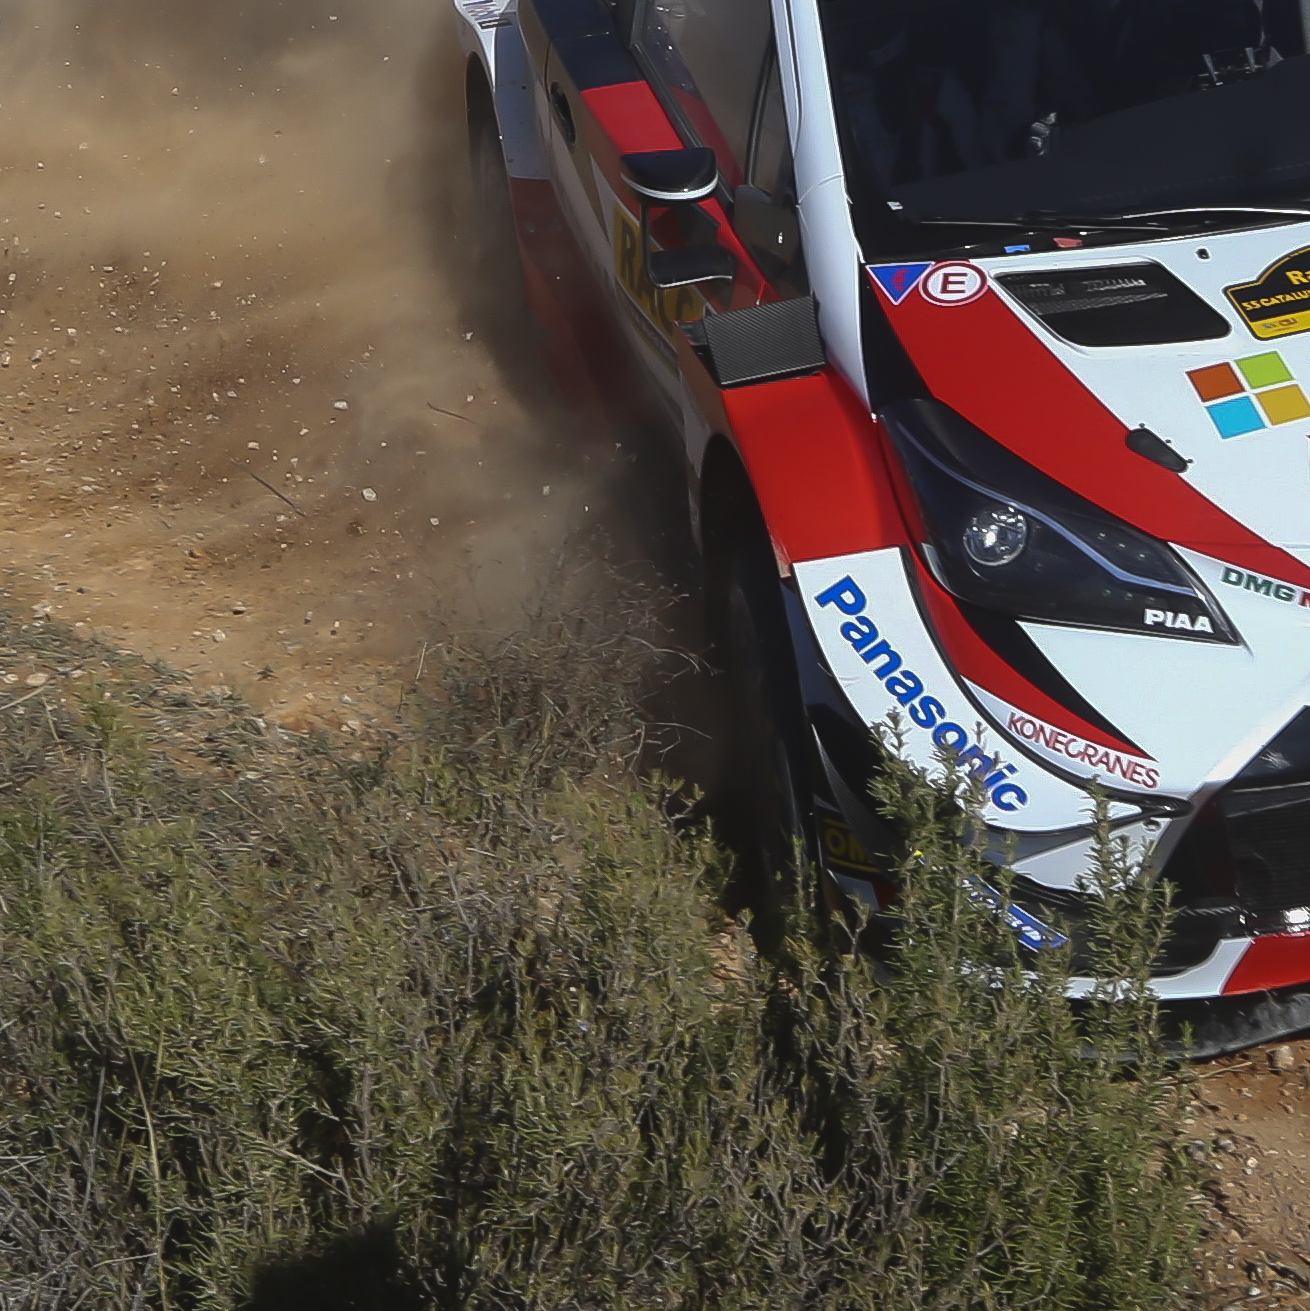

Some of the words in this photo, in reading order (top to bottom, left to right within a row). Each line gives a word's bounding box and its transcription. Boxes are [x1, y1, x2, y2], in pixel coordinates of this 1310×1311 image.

[939, 272, 968, 294] E
[1220, 566, 1298, 603] DMG
[1143, 607, 1215, 634] PIAA
[813, 574, 1029, 813] Panasonic
[1006, 710, 1162, 790] KONECRANES
